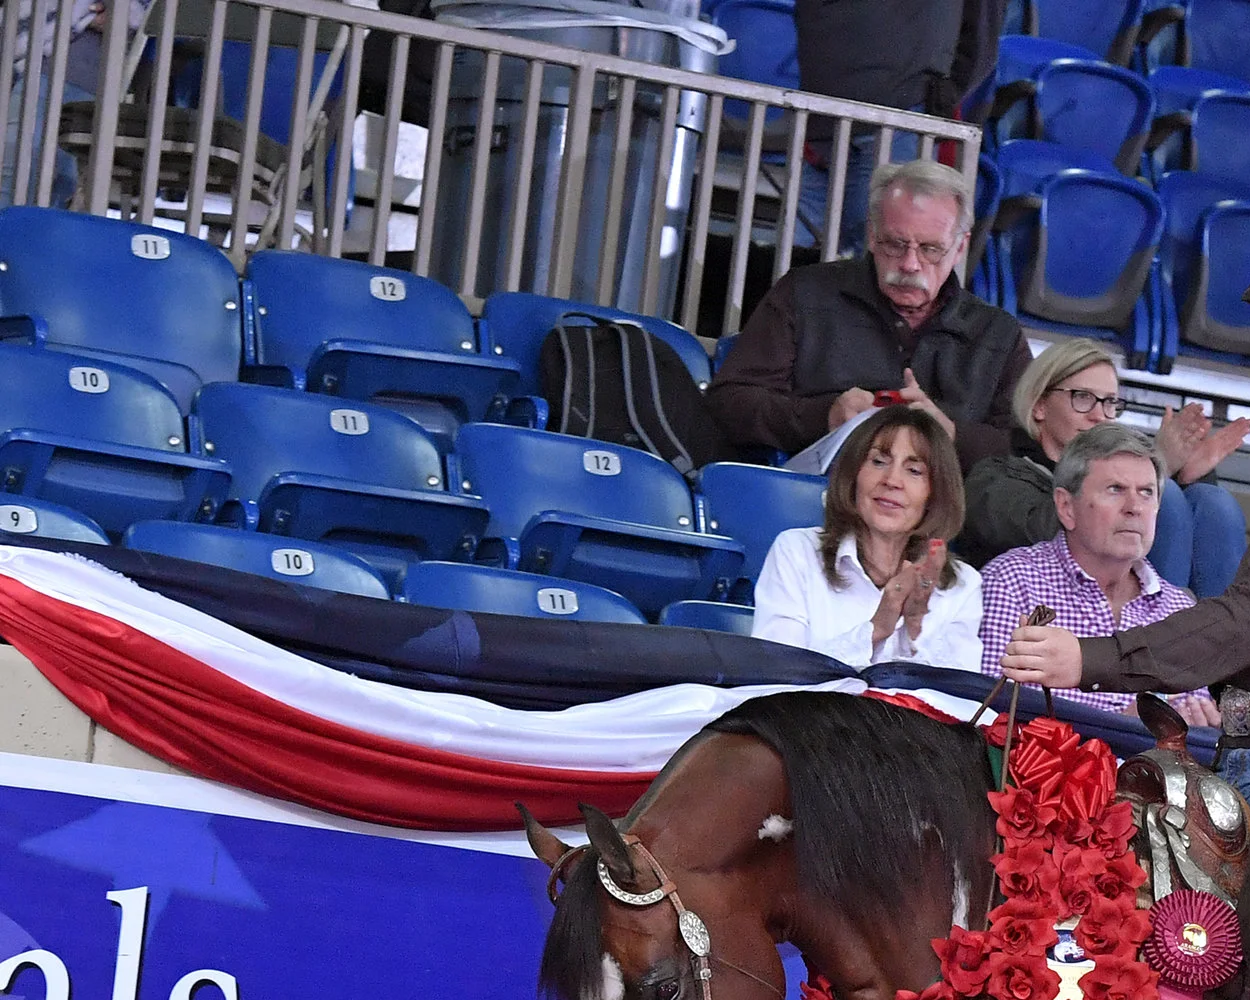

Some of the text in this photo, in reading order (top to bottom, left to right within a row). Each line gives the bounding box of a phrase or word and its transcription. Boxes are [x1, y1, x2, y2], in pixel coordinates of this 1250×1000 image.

[142, 239, 158, 256] 11
[380, 280, 396, 297] 12
[81, 371, 99, 388] 10
[340, 414, 358, 431] 11
[594, 455, 611, 471] 12
[11, 511, 20, 527] 9
[284, 553, 301, 569] 10
[549, 593, 566, 610] 11
